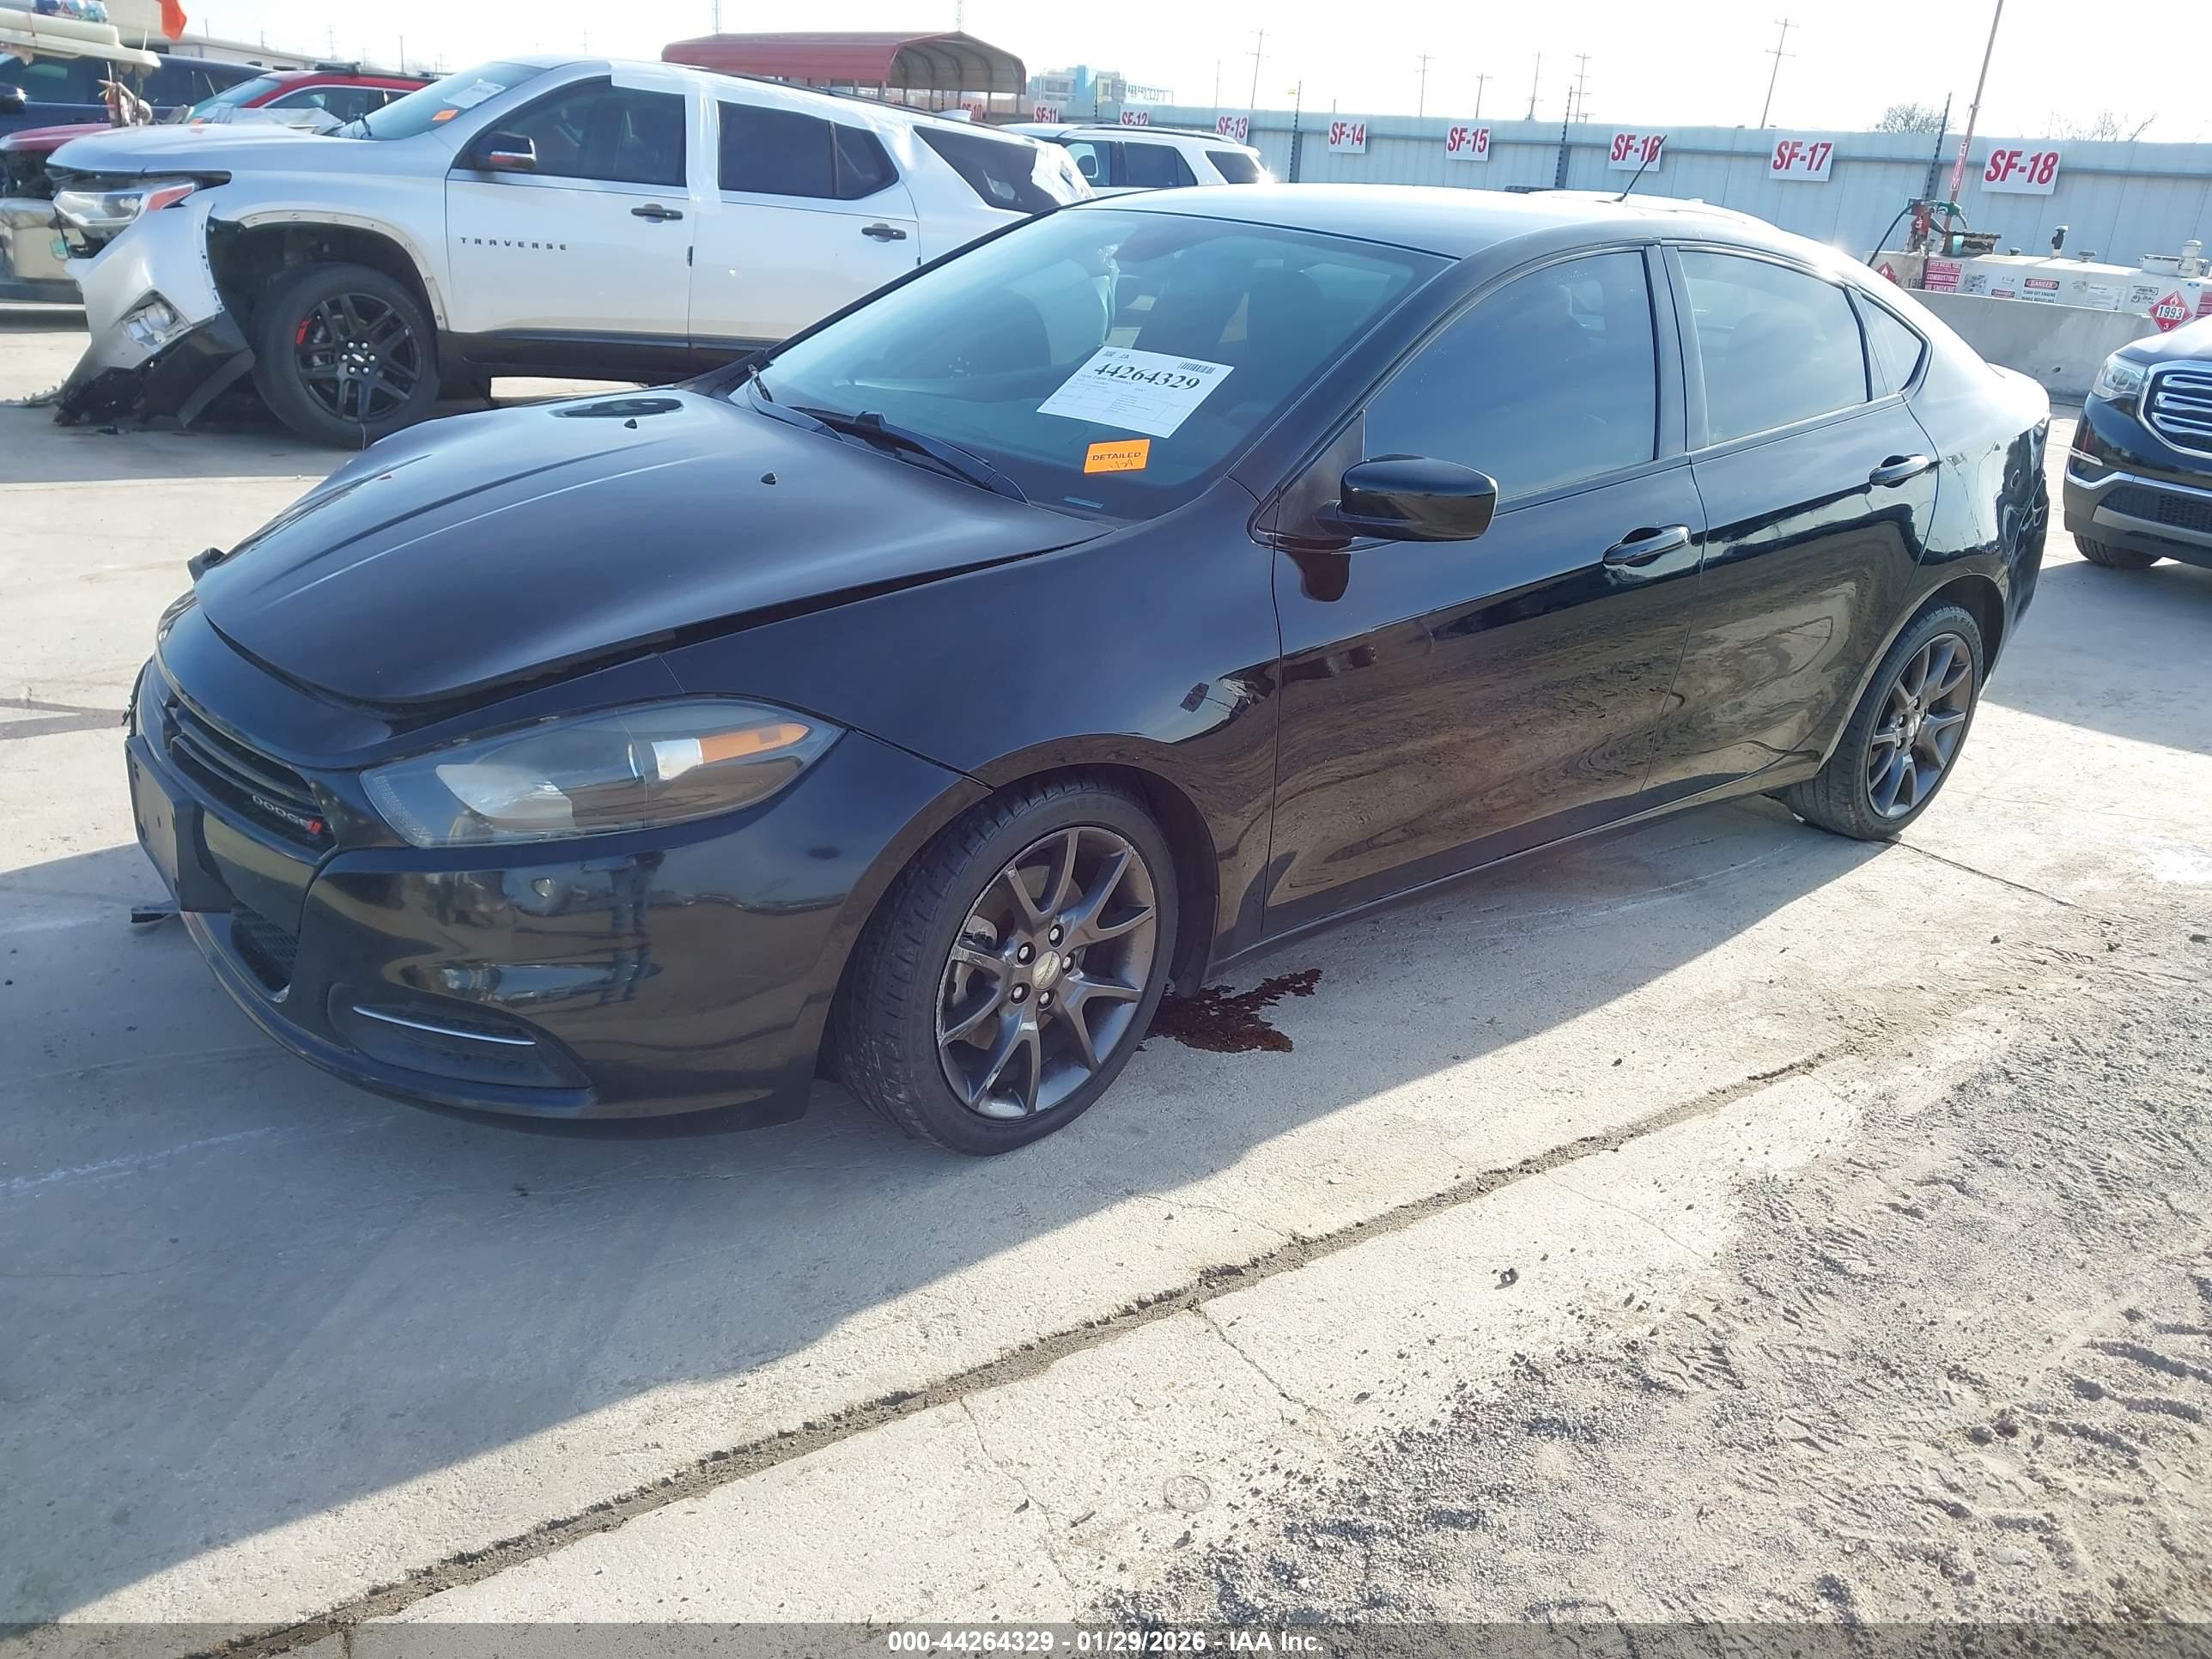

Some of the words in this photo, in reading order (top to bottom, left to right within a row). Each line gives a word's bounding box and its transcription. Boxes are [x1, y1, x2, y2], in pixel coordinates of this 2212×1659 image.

[1036, 106, 1057, 123] SF-11
[1121, 112, 1148, 125] SF-12
[1217, 116, 1248, 139] SF-13
[1330, 122, 1365, 146] SF-14
[1448, 127, 1489, 153] SF-15
[1611, 134, 1662, 162] SF-16
[1772, 140, 1833, 172] SF-17
[1985, 149, 2059, 185] SF-18
[460, 237, 567, 251] TRAVERSE
[1926, 273, 1959, 283] COMBUSTIBLE
[2159, 306, 2183, 319] 1993
[1093, 362, 1200, 391] 44264329
[1092, 452, 1141, 461] DETAILED
[252, 794, 310, 828] DODGE
